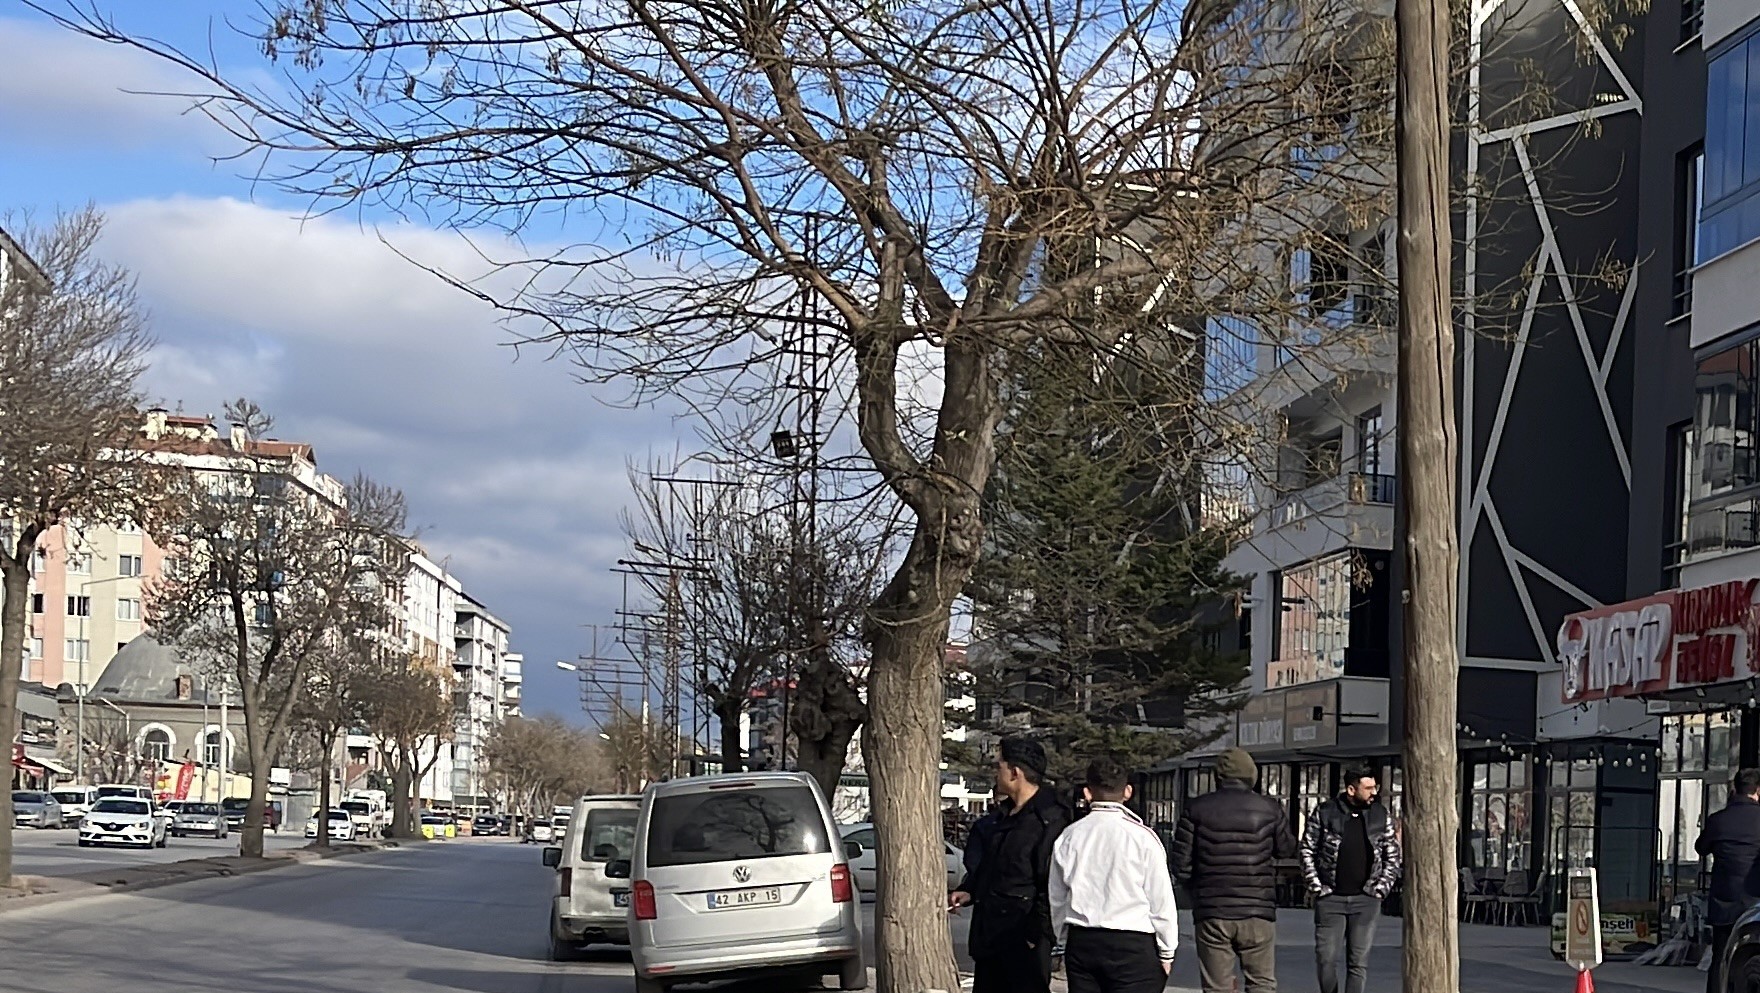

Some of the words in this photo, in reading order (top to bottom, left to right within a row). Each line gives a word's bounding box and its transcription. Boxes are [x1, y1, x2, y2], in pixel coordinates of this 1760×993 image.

[715, 895, 729, 905] 42
[737, 892, 757, 903] AKP
[765, 890, 778, 901] 15
